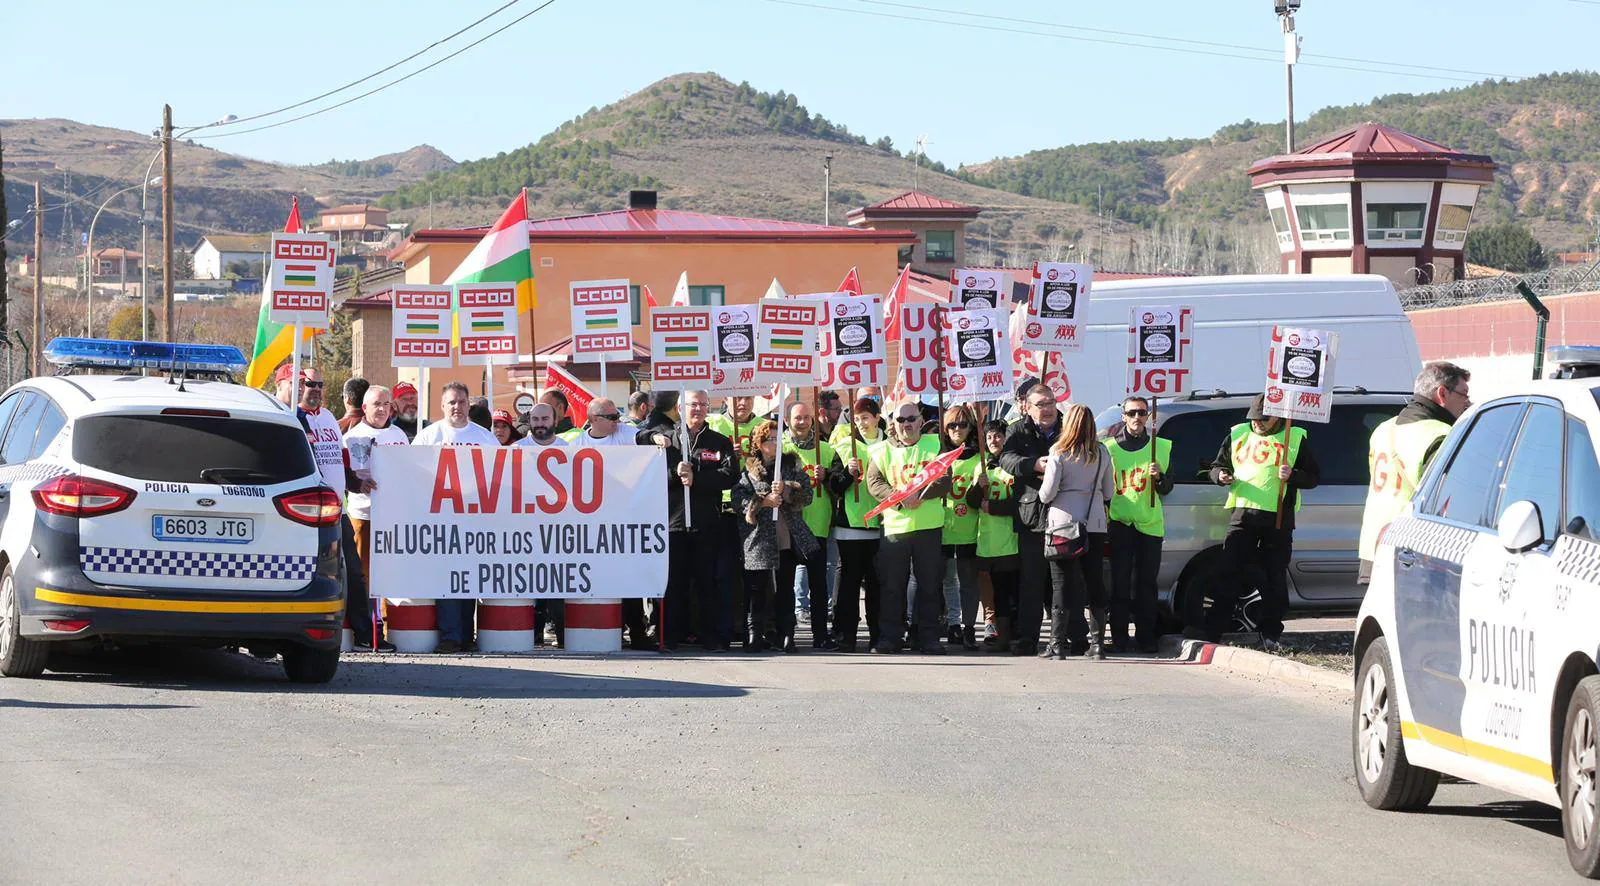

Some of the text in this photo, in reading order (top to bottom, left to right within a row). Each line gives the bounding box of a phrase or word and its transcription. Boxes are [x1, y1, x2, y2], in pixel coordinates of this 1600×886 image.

[279, 244, 324, 256] CCOO
[276, 295, 322, 307] CCOO
[399, 294, 448, 306] CCOO
[463, 292, 514, 304] CCOO
[577, 289, 624, 302] CCOO
[765, 308, 813, 321] CCOO
[656, 316, 706, 328] CCOO
[398, 341, 447, 353] CCOO
[464, 339, 513, 352] CCOO
[579, 336, 626, 348] CCOO
[761, 355, 808, 369] CCOO
[658, 364, 707, 377] CCOO
[430, 447, 604, 514] A.VI.SO
[1114, 466, 1150, 495] UG
[145, 482, 189, 494] POLICIA
[165, 519, 207, 535] 6603
[216, 520, 247, 537] JTG
[375, 523, 666, 554] EN LUCHA POR LOS VIGILANTES
[451, 563, 591, 593] DE PRISIONES
